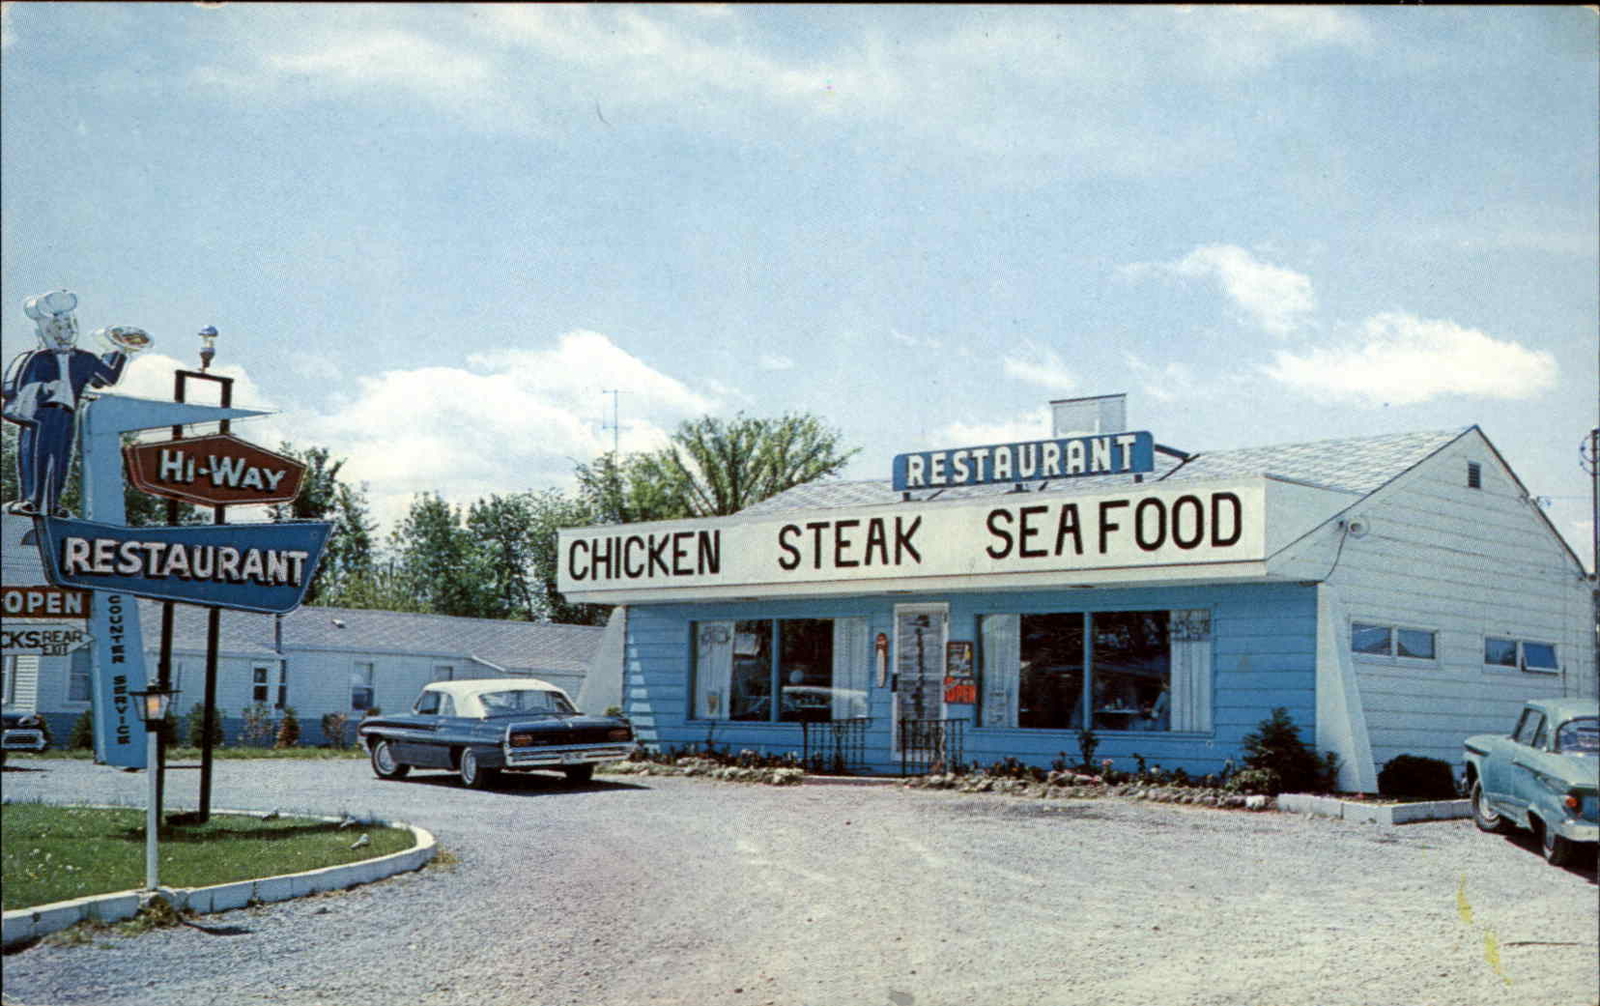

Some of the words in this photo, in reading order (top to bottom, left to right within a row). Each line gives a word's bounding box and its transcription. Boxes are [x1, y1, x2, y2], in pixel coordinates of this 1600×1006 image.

[906, 434, 1138, 488] RESTAURANT
[64, 537, 309, 587] RESTAURANT
[568, 529, 722, 581] CHICKEN
[778, 515, 922, 570] STEAK
[4, 591, 82, 613] OPEN
[42, 631, 82, 643] REAR
[108, 595, 125, 664] COUNTER
[113, 675, 131, 745] SERVICE
